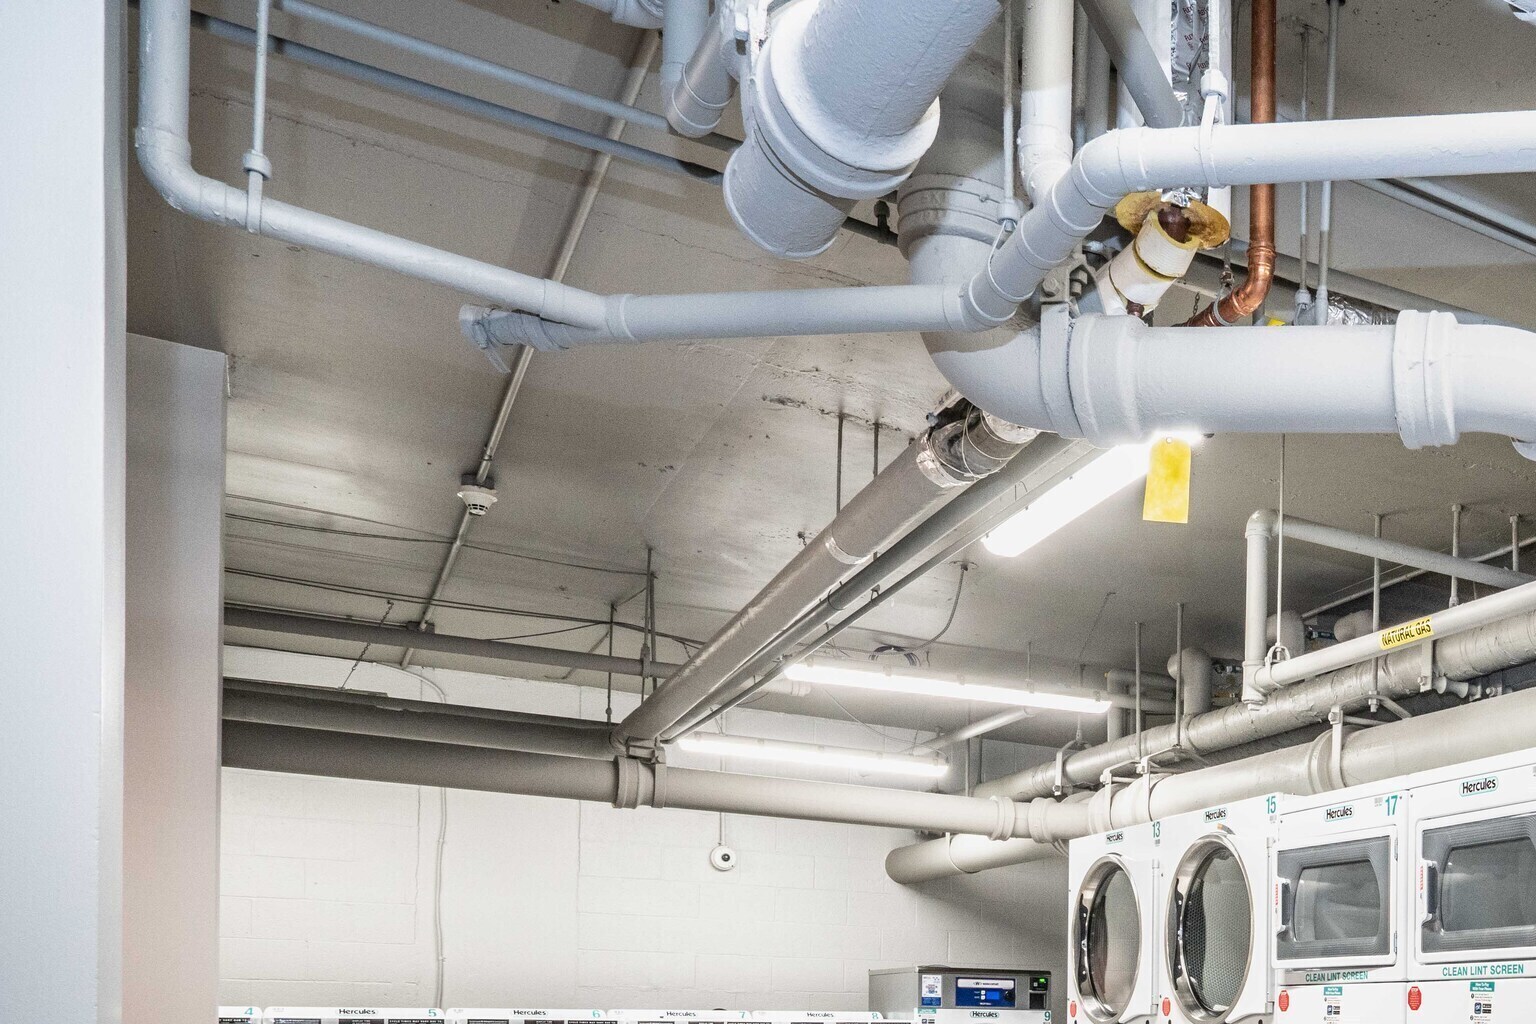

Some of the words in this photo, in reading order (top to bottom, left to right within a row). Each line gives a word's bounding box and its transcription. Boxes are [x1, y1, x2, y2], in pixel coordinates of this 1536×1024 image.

[1382, 625, 1414, 646] NATURAL
[1416, 619, 1431, 636] GAS
[1462, 778, 1496, 794] Hercules
[1266, 795, 1277, 814] 15
[1385, 795, 1398, 816] 17
[1205, 808, 1226, 821] Hercules
[1326, 806, 1352, 820] Hercules
[1152, 821, 1161, 838] 13
[1305, 973, 1325, 982] CLEAN
[1327, 972, 1340, 981] LINT
[1342, 971, 1368, 980] SCREEN
[1442, 967, 1467, 977] CLEAN
[1470, 966, 1488, 975] LINT
[1490, 964, 1524, 975] SCREEN
[428, 1009, 437, 1017] 5
[592, 1010, 600, 1018] 6
[1044, 1011, 1051, 1021] 9
